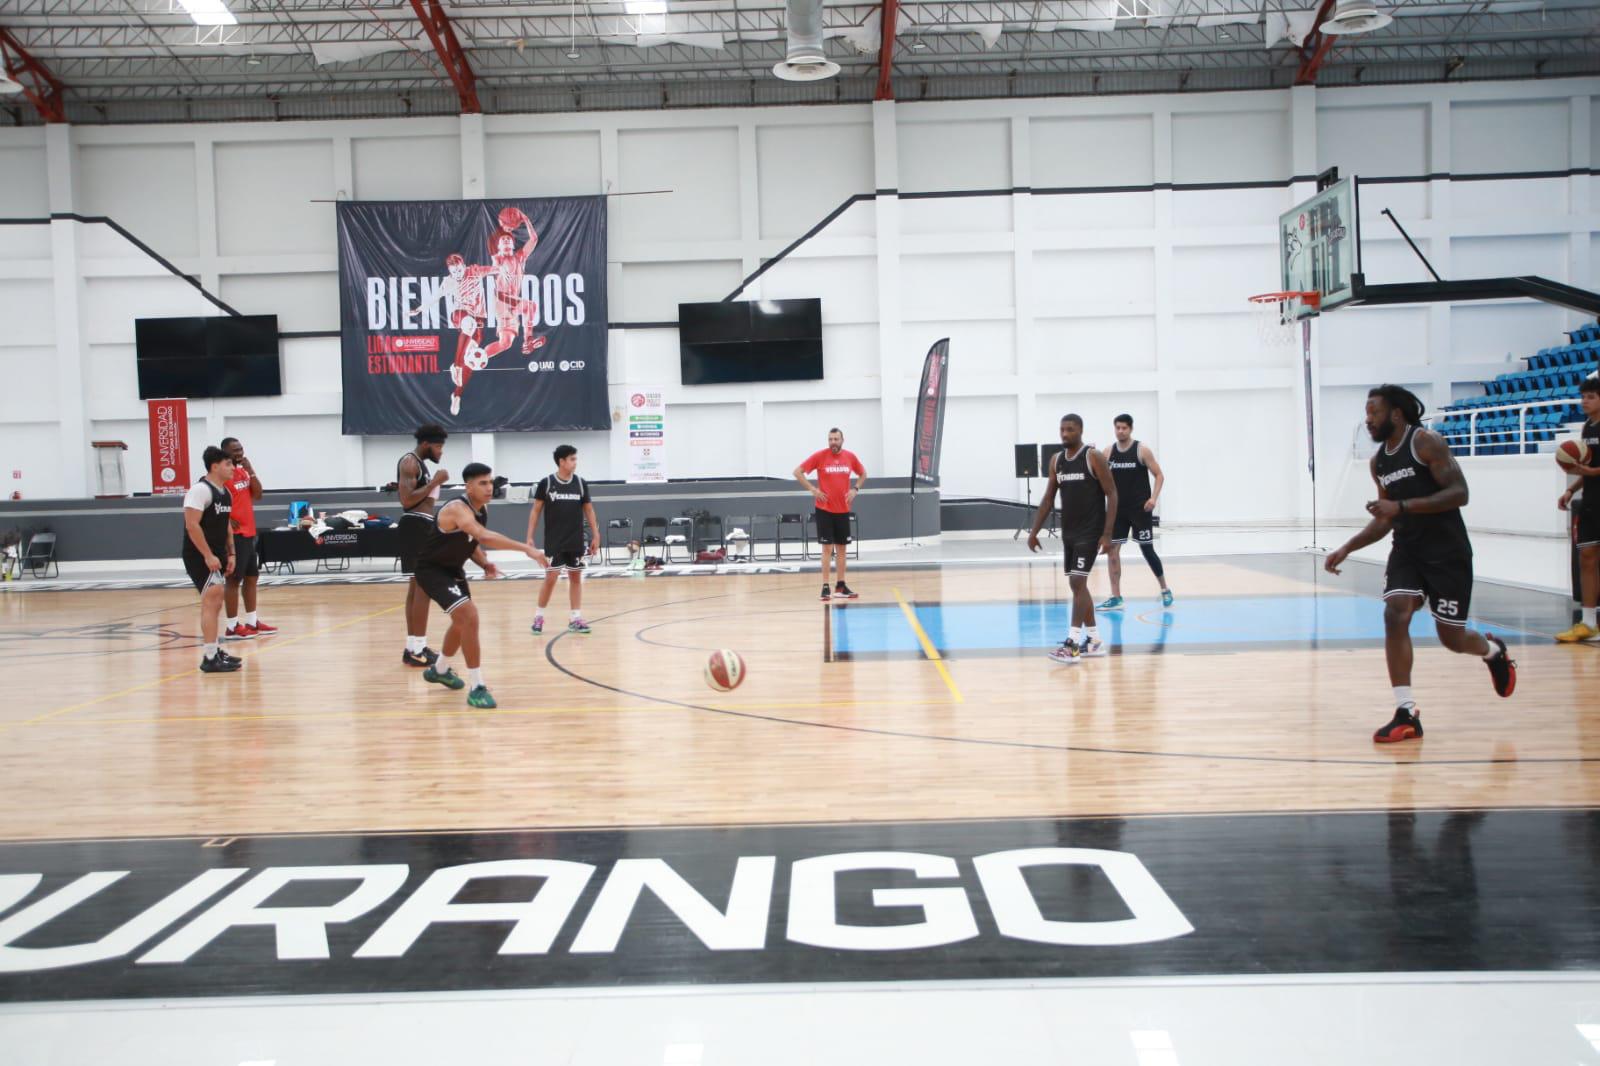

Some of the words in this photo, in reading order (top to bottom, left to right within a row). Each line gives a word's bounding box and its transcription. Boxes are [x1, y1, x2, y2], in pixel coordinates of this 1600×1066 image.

[570, 360, 585, 369] CID
[157, 406, 170, 467] UNIVERSIDAD
[1139, 530, 1151, 539] 23
[1077, 557, 1085, 568] 5
[1437, 599, 1458, 616] 25
